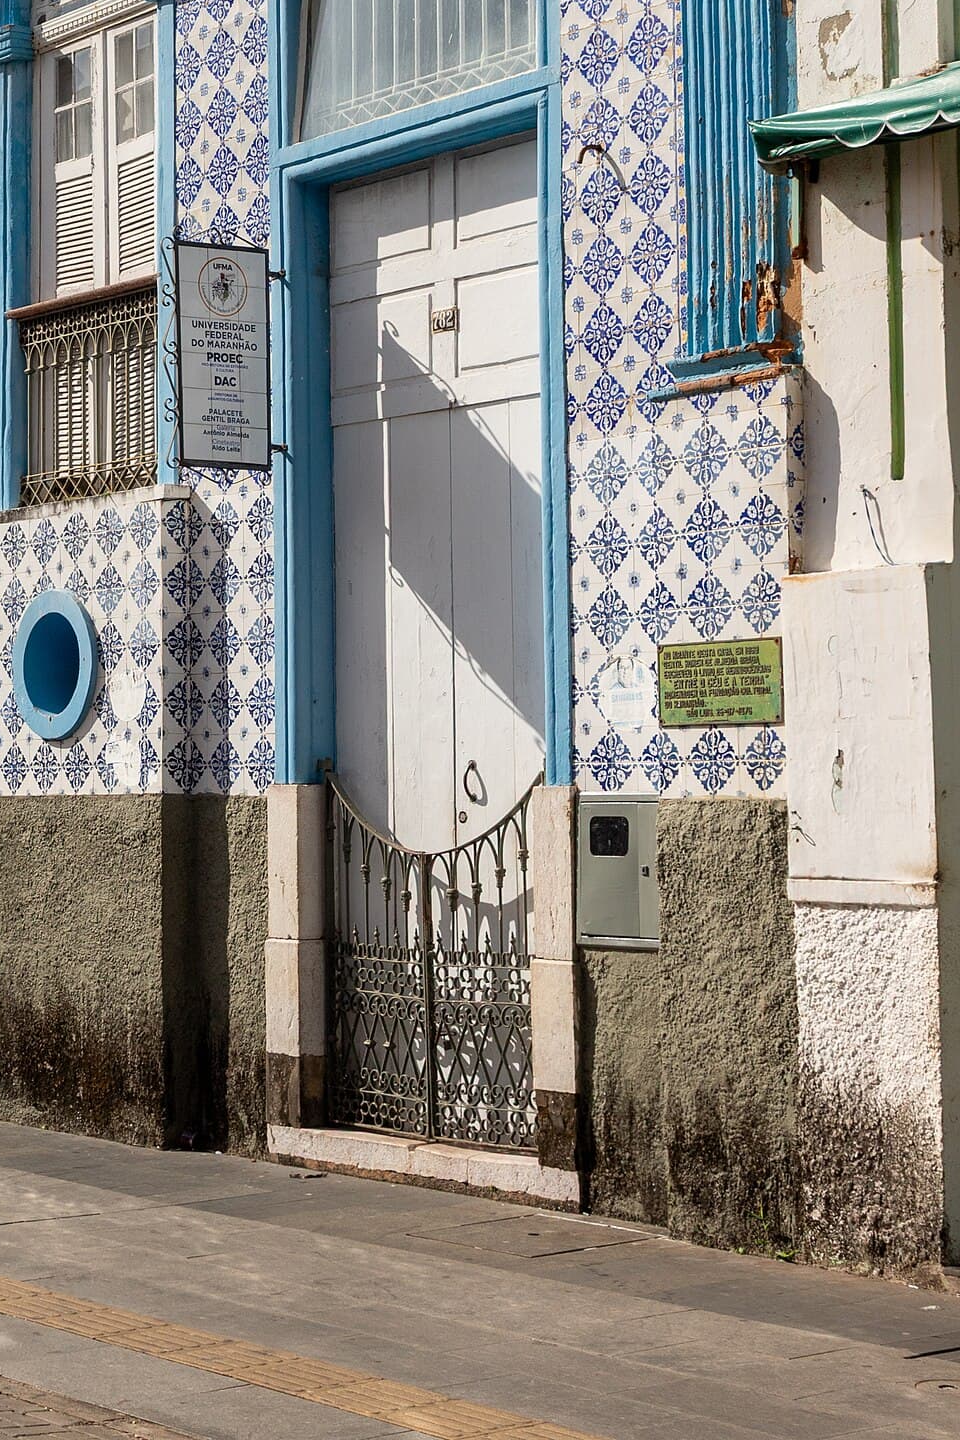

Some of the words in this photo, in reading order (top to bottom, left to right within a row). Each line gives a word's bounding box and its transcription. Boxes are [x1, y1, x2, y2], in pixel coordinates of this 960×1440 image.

[212, 263, 232, 271] UFMA
[192, 320, 256, 332] UNIVERSIDADE
[205, 330, 244, 340] FEDERAL
[192, 339, 204, 347] DO
[207, 341, 257, 351] MARANHÃO
[207, 352, 243, 364] PROEC
[214, 376, 236, 386] DAC
[209, 408, 242, 417] PALACETE
[201, 415, 225, 423] GENTIL
